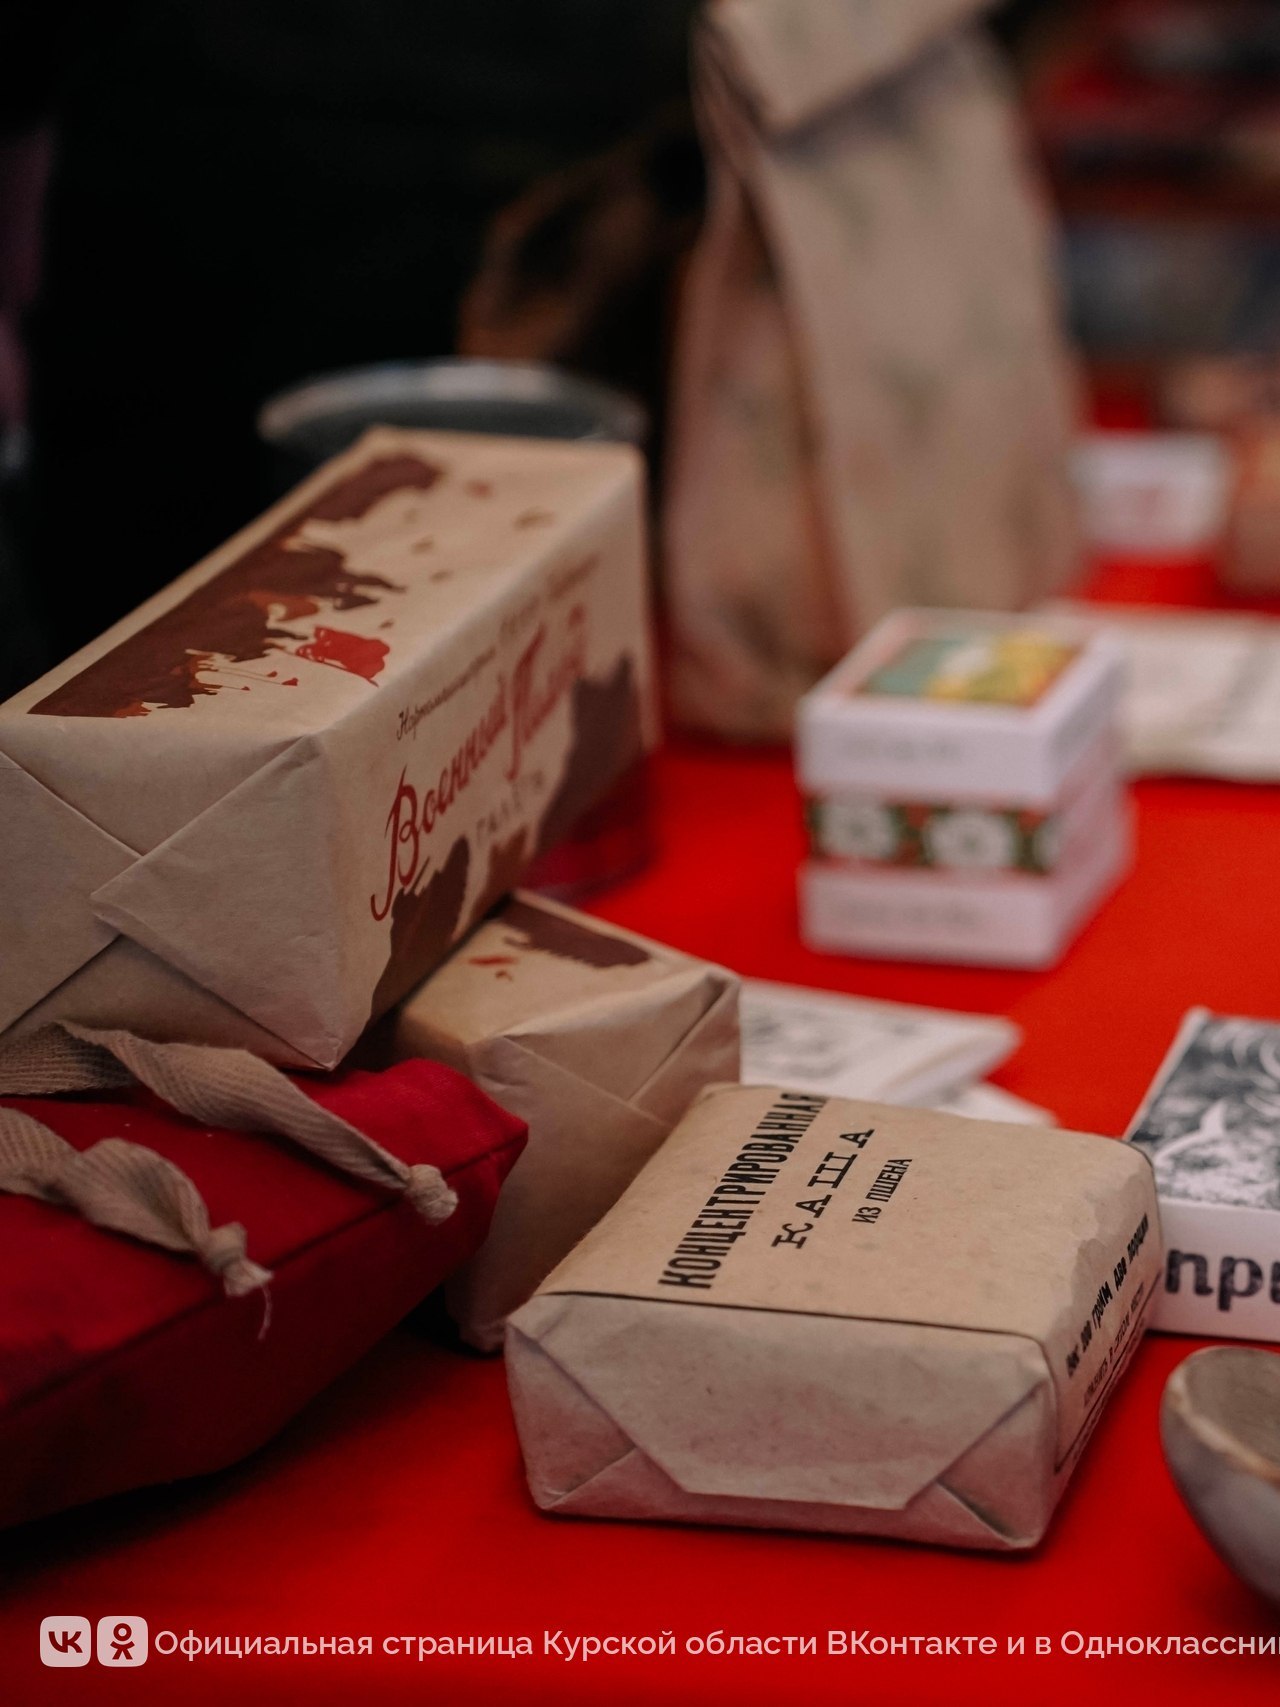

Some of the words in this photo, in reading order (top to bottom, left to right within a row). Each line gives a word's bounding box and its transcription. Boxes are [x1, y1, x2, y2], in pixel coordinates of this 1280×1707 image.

[658, 1093, 830, 1290] КОНЦЕНТРИРОВАННАЯ
[770, 1128, 875, 1250] КАША
[851, 1206, 882, 1224] ИЗ
[865, 1158, 913, 1203] ПШЕНА
